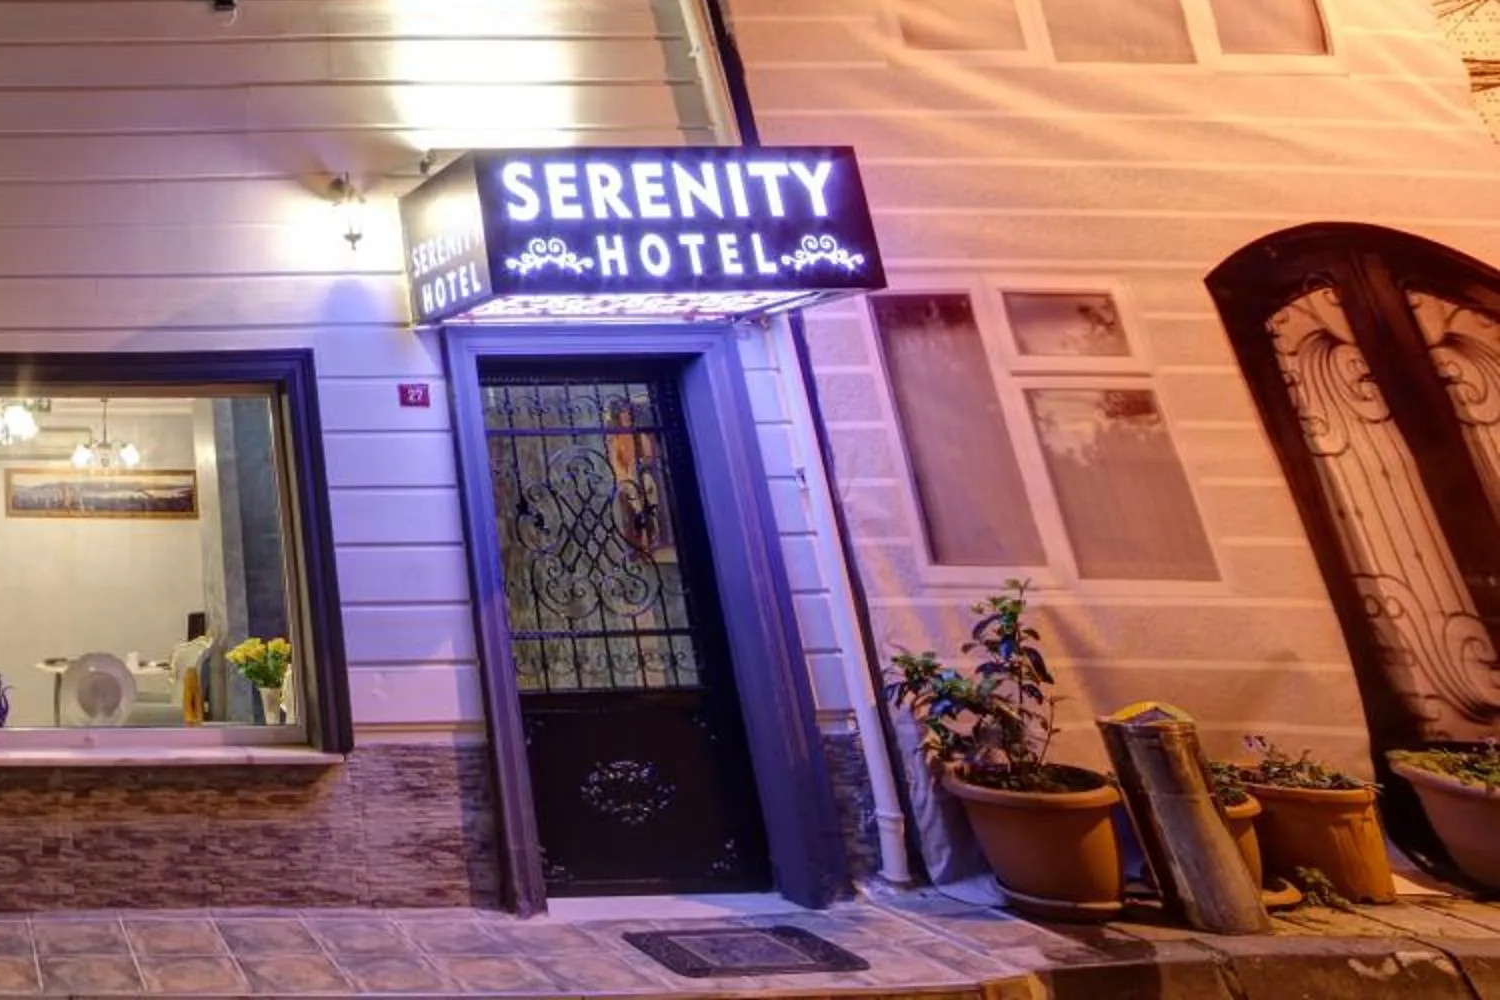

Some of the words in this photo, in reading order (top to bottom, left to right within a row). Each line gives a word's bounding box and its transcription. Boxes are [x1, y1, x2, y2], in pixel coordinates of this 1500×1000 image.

[502, 161, 832, 221] SERENITY
[596, 233, 778, 277] HOTEL
[422, 261, 481, 314] HOTEL
